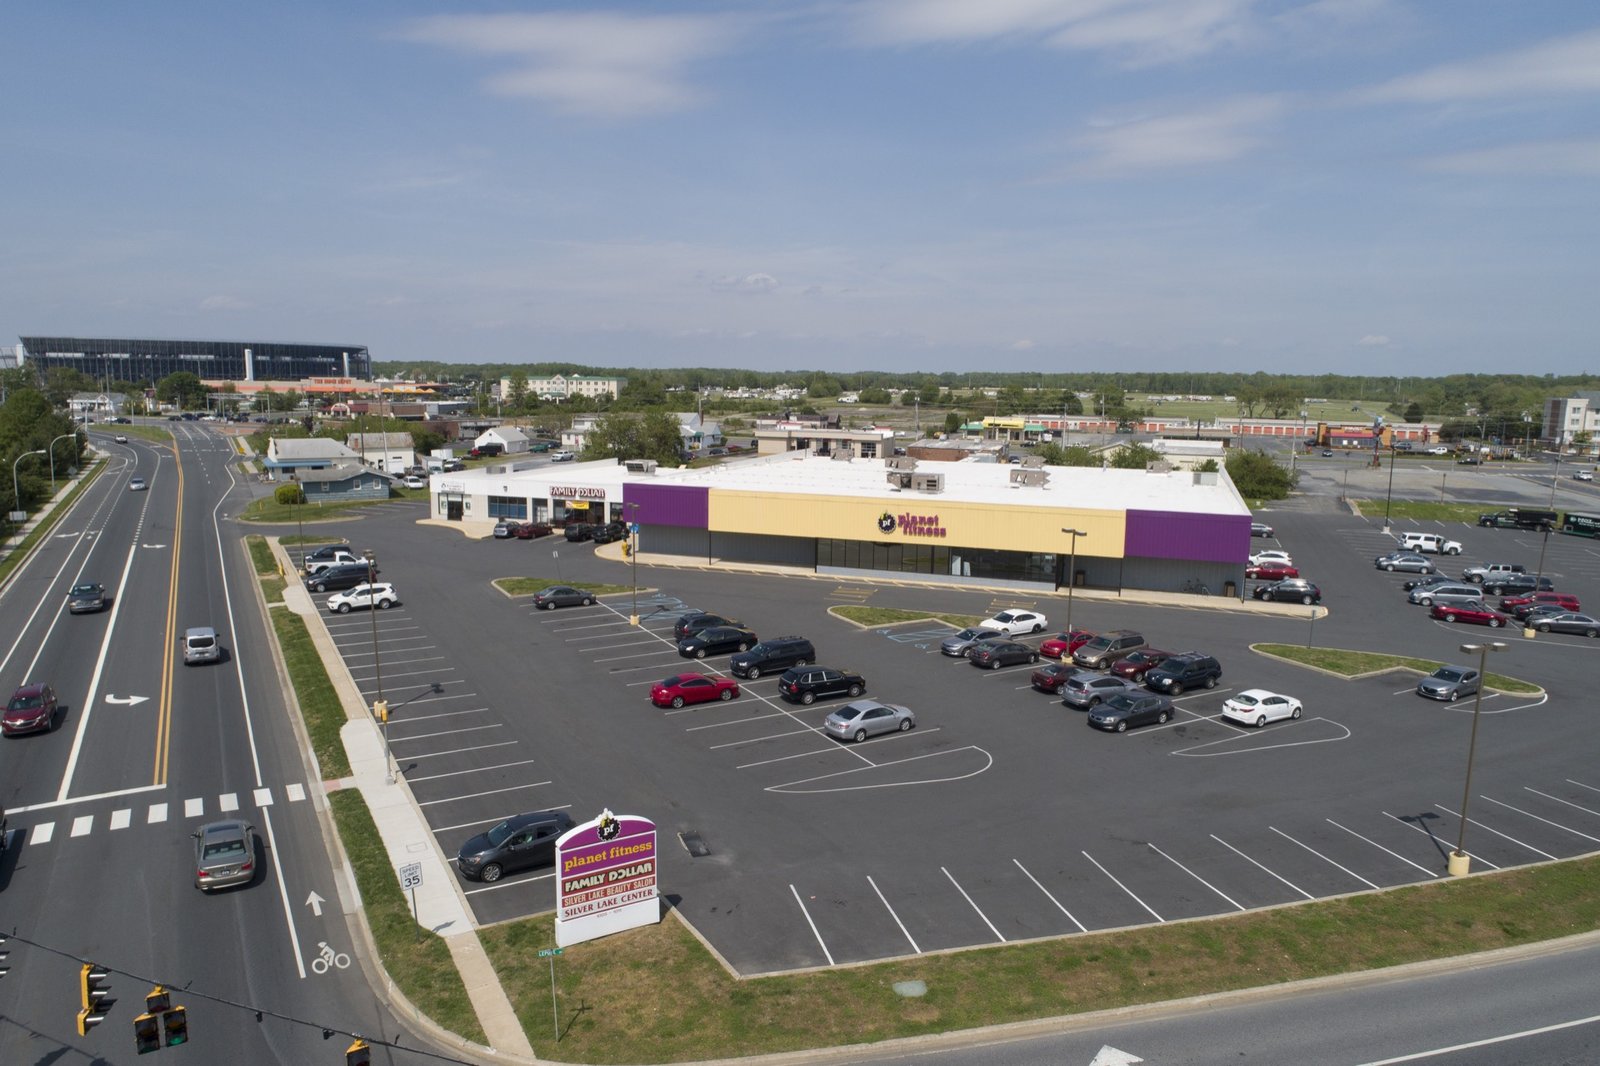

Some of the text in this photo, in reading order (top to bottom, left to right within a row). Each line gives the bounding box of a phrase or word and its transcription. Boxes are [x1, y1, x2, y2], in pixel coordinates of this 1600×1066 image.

[550, 485, 606, 498] FAMILY DOLLAR
[882, 519, 891, 528] pf
[898, 512, 939, 528] planet
[903, 521, 947, 538] fitness
[603, 823, 615, 836] pf
[564, 841, 653, 872] planet fitness
[402, 865, 420, 874] SPEED
[565, 862, 653, 892] FAMILY DOLLAR
[404, 874, 420, 887] 35
[564, 877, 654, 907] SILVER LAKE BEAUTY SALON
[564, 903, 594, 917] SILVER
[597, 898, 618, 909] LAKE
[621, 888, 653, 903] CENTER
